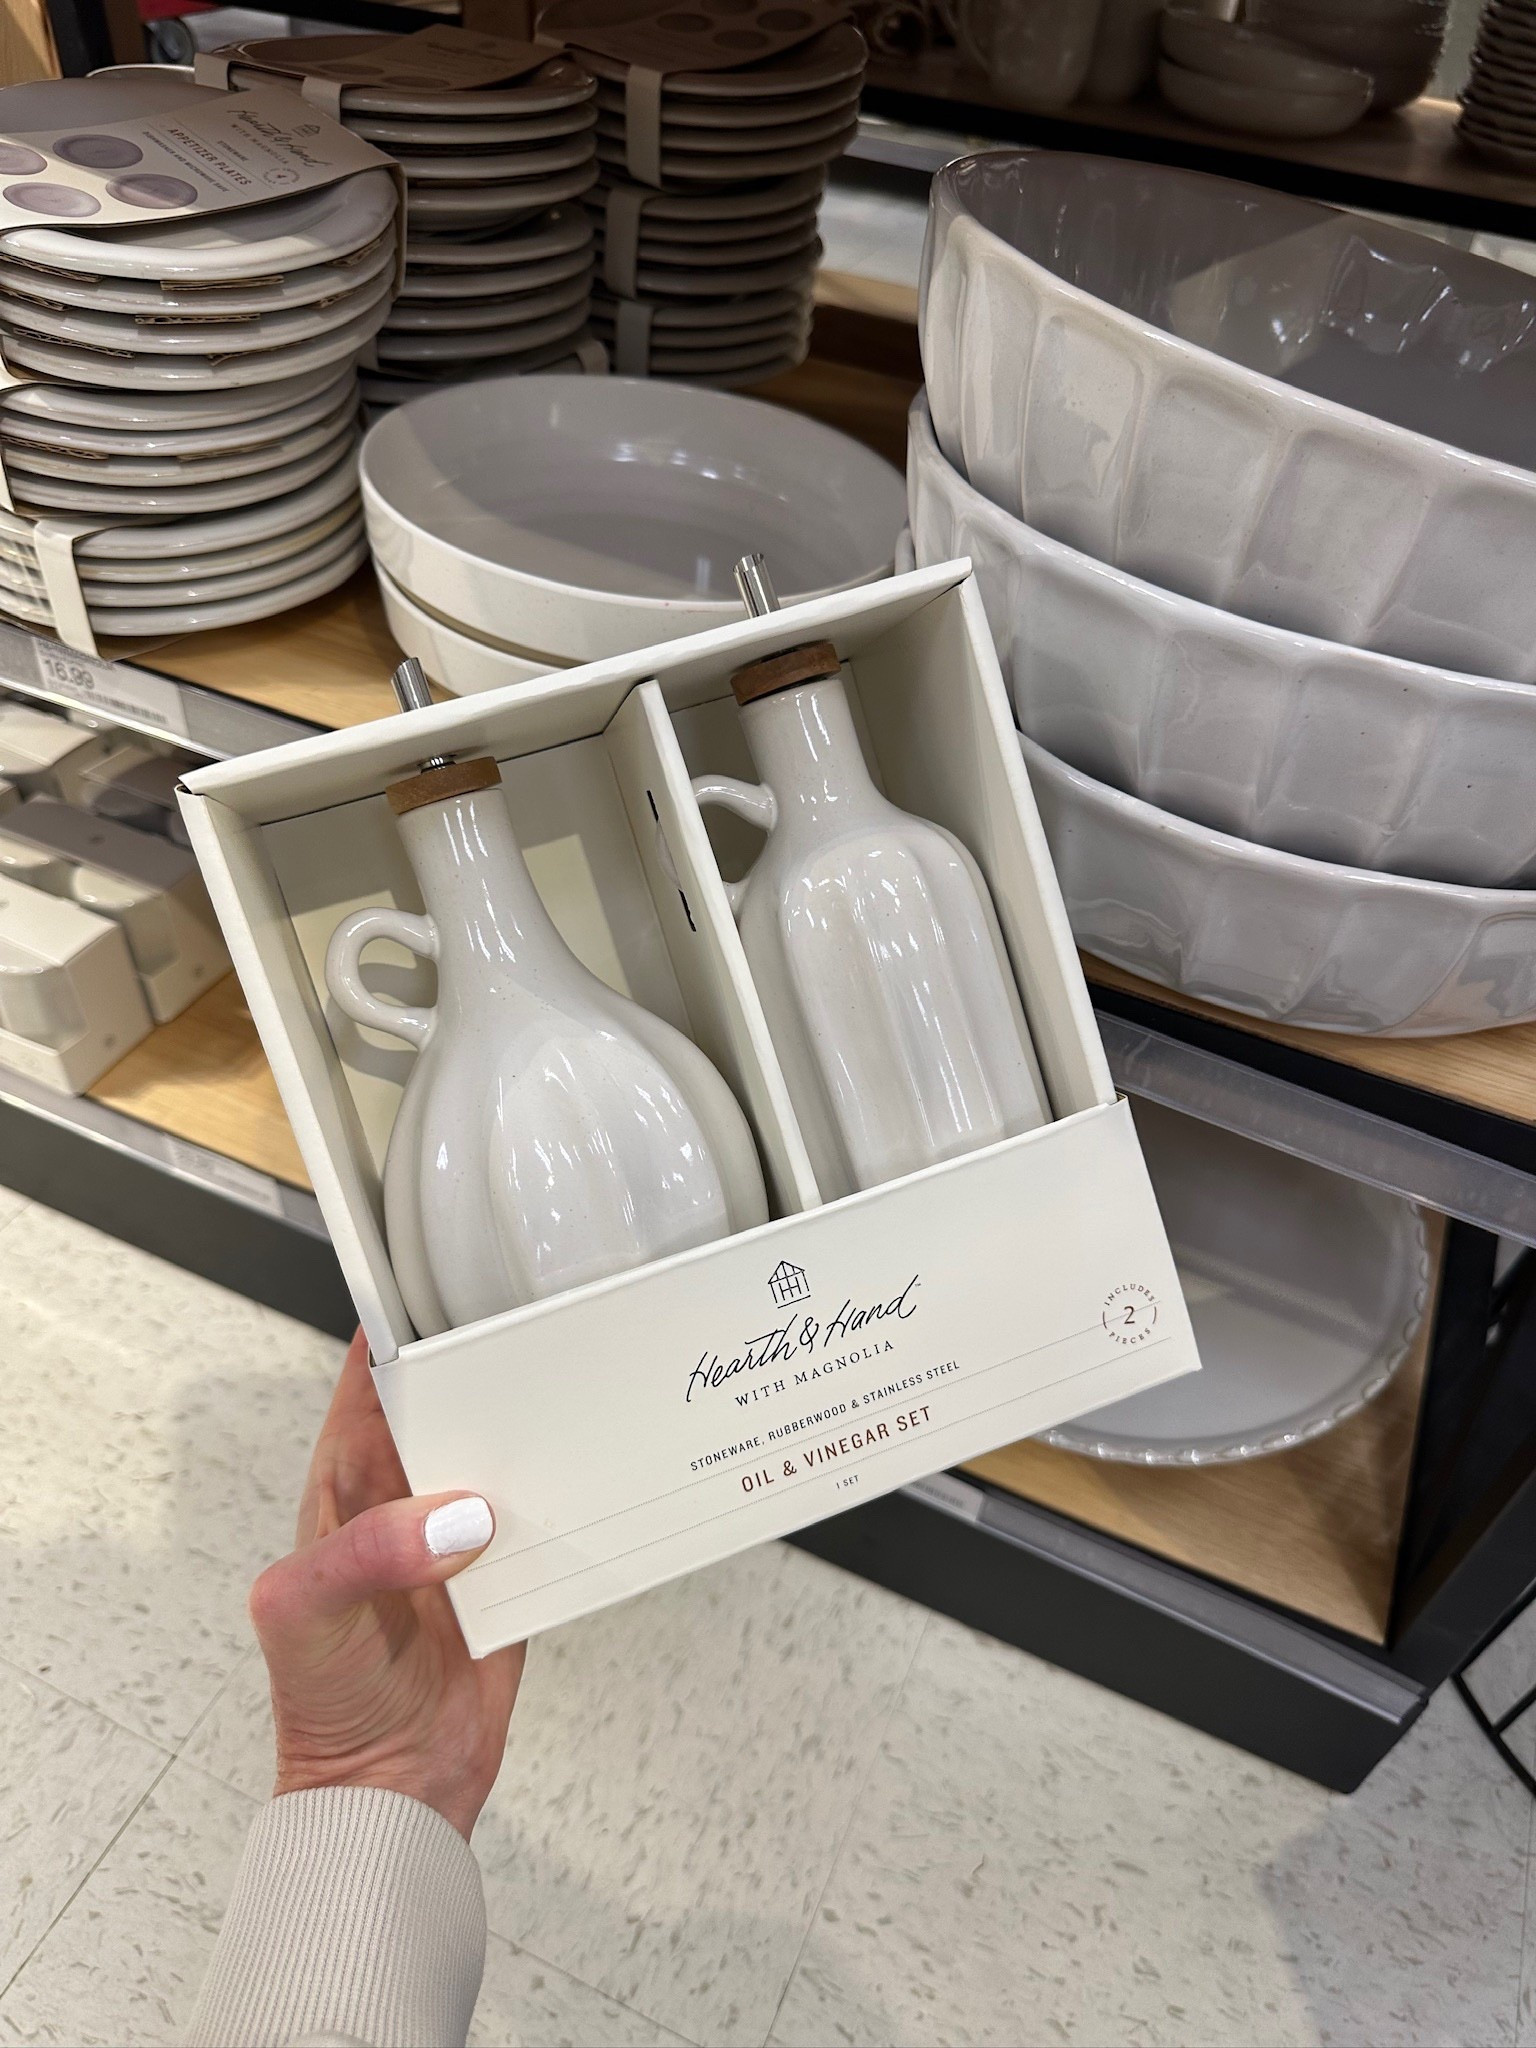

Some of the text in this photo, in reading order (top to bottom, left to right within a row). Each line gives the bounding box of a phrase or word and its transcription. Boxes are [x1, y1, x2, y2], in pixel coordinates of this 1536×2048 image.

[167, 128, 219, 161] APPETIZER
[214, 161, 252, 187] PLATES
[44, 658, 95, 690] 16.99
[1104, 1283, 1155, 1306] INCLUDES
[1124, 1305, 1136, 1325] 2
[686, 1313, 798, 1402] Hearth
[799, 1316, 820, 1354] &
[824, 1274, 919, 1348] Hand
[1108, 1327, 1151, 1345] PIECES
[735, 1340, 894, 1407] WITH MAGNOLIA
[690, 1360, 961, 1472] STONEWARE, RUBBERWOOD & STAINLESS STEEL
[741, 1405, 931, 1493] OIL & VINEGAR SET
[843, 1475, 860, 1488] SET
